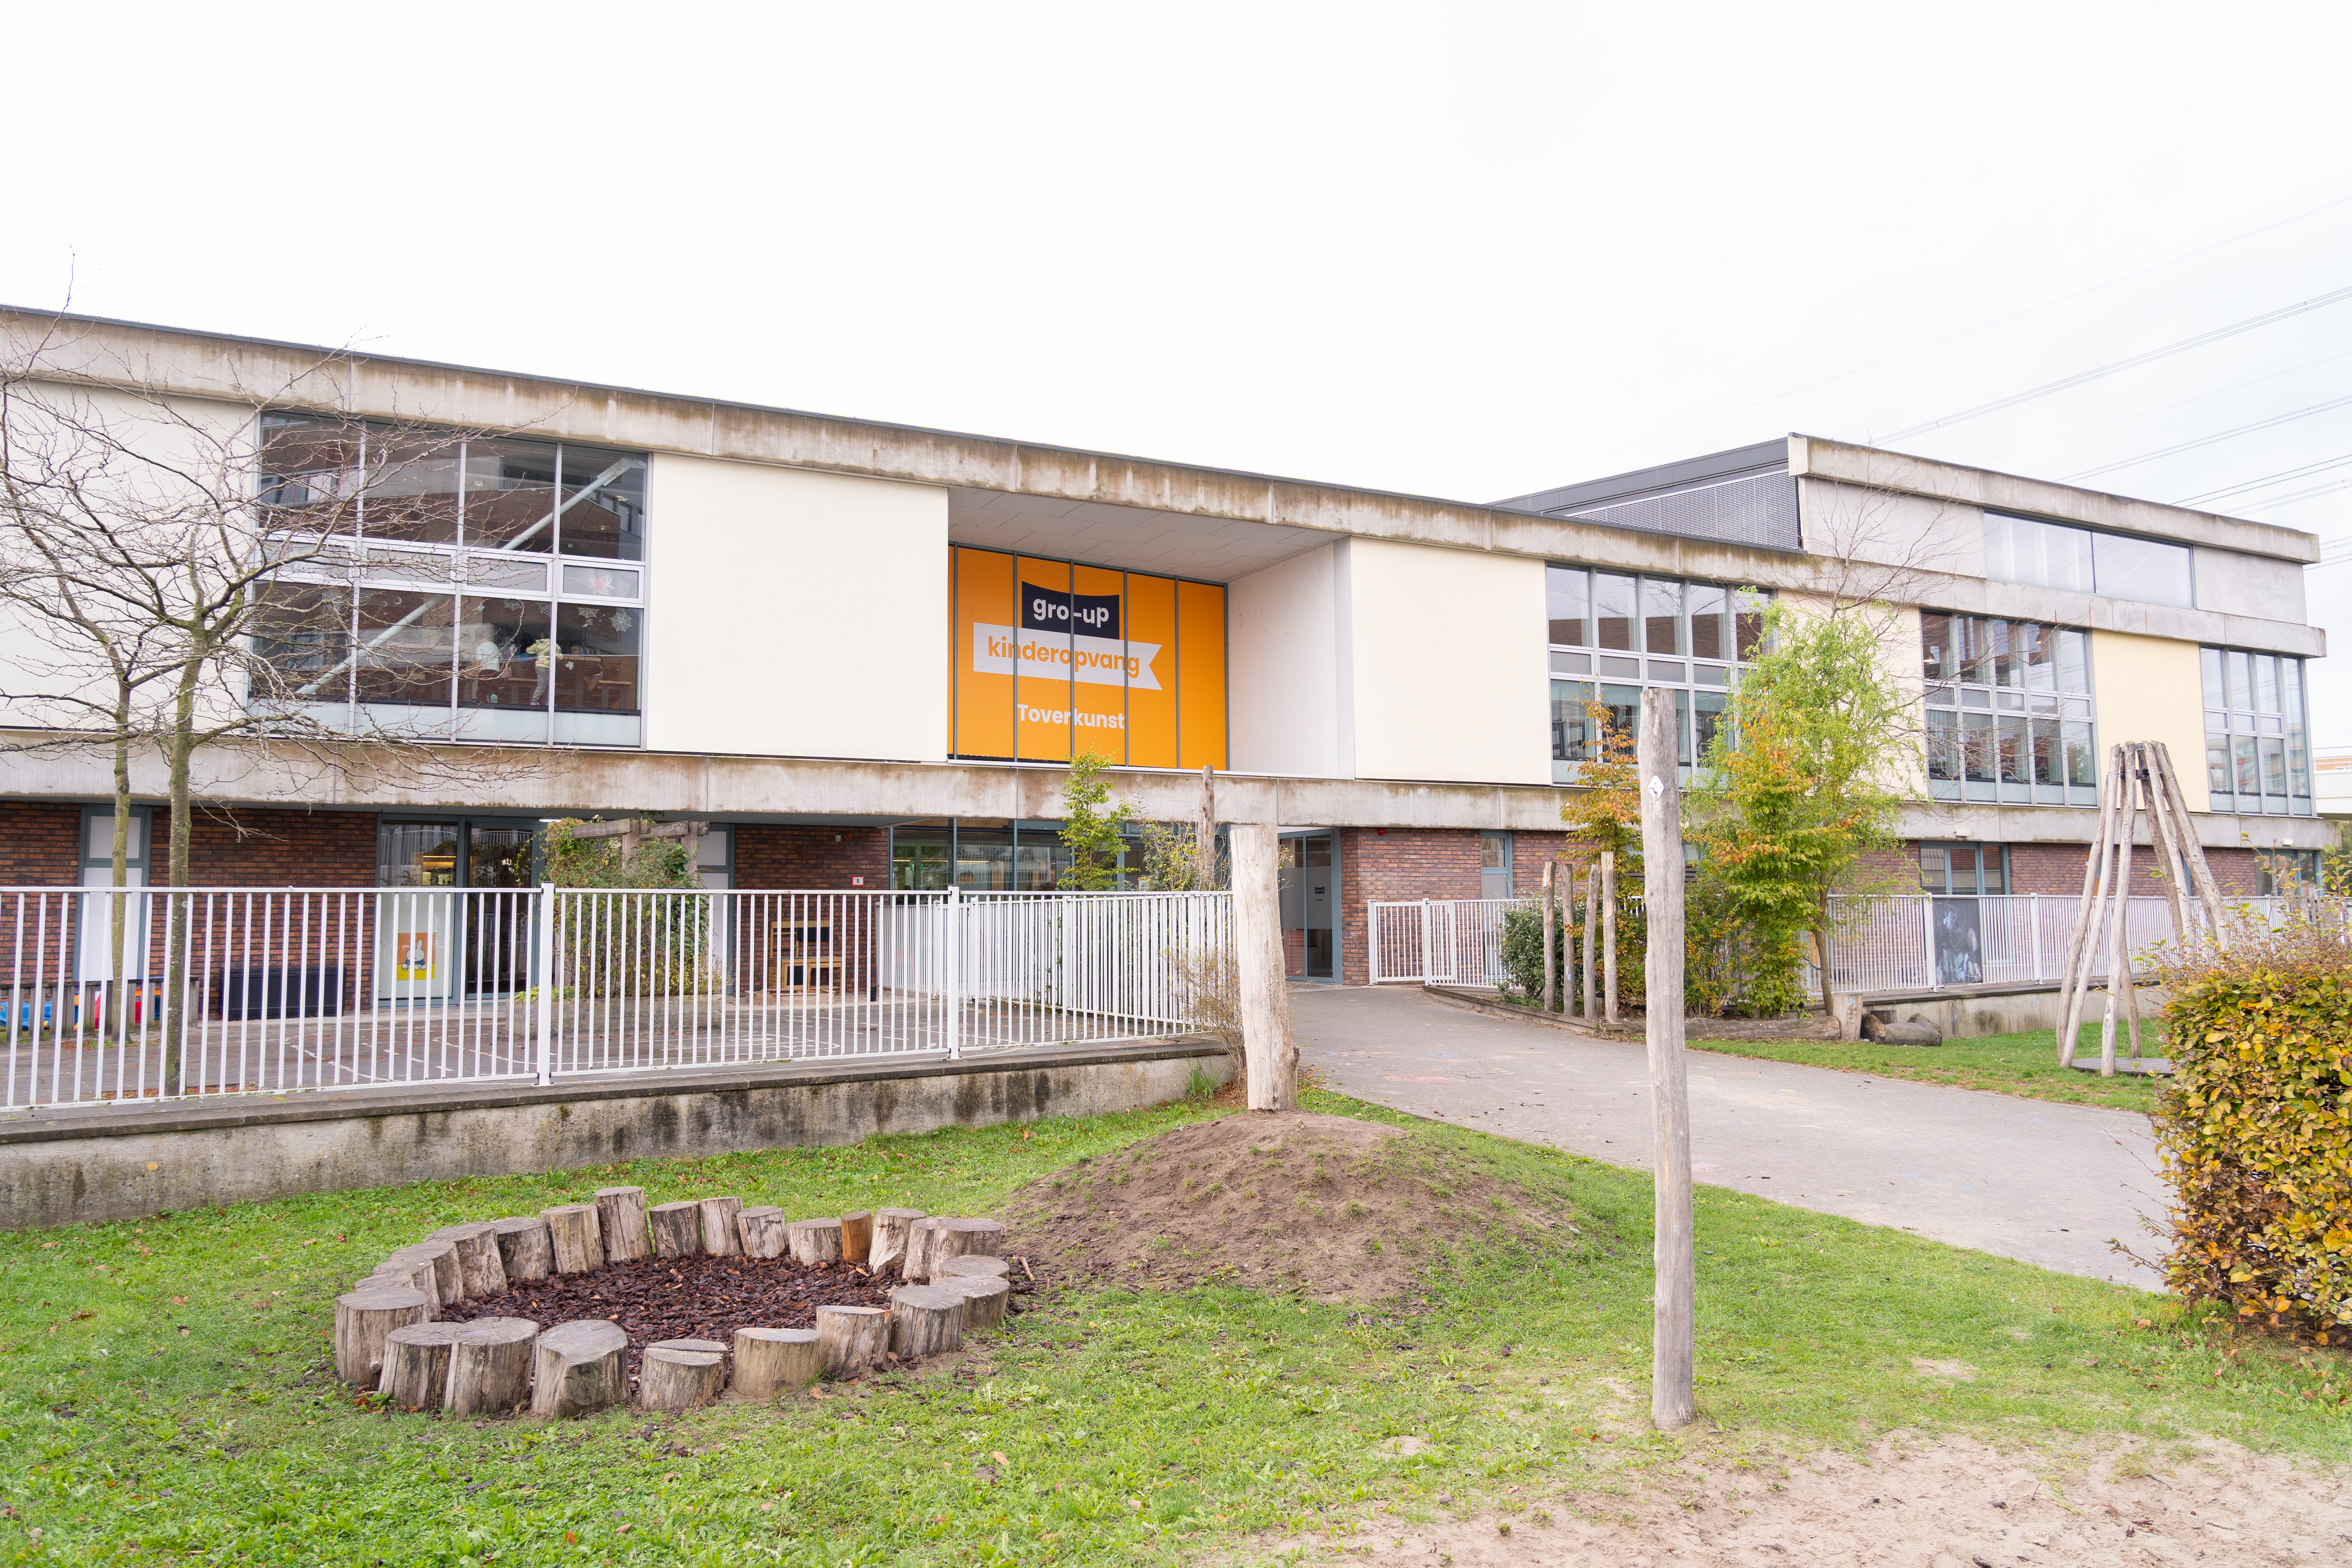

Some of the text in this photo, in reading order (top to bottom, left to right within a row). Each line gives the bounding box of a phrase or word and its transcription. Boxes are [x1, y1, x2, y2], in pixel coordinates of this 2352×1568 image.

[1033, 598, 1109, 628] gro-up
[988, 636, 1140, 678] kinderopvang
[1017, 704, 1125, 730] Toverkunst
